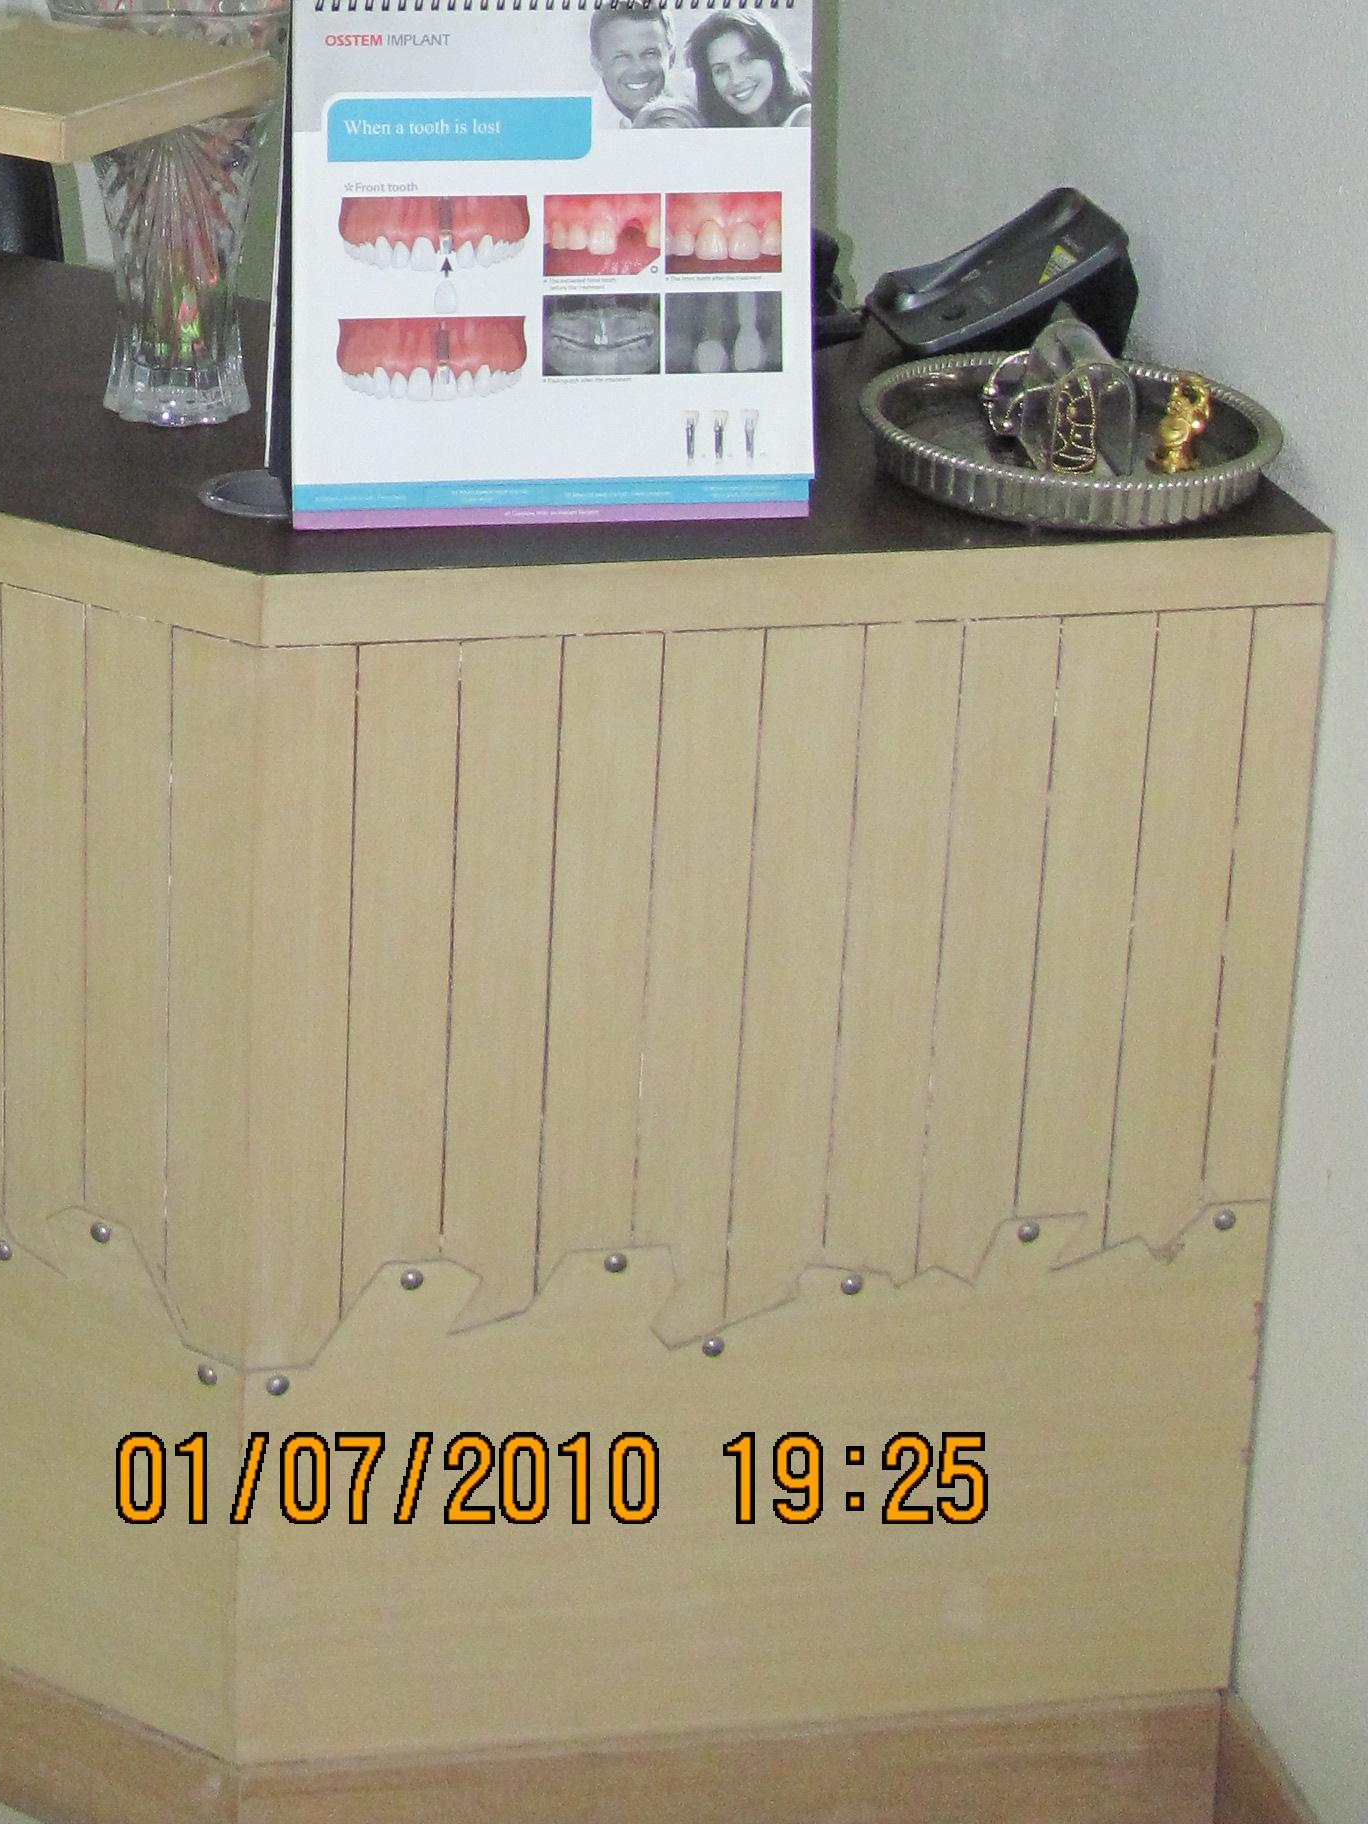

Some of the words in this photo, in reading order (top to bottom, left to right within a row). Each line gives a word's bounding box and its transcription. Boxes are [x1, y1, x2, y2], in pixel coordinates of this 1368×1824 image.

[324, 33, 383, 47] OSSTEM
[386, 32, 451, 47] IMPLANT
[343, 118, 392, 136] When
[395, 122, 404, 135] a
[408, 118, 450, 135] tooth
[453, 118, 468, 134] is
[471, 117, 501, 134] lost
[387, 182, 419, 192] tooth
